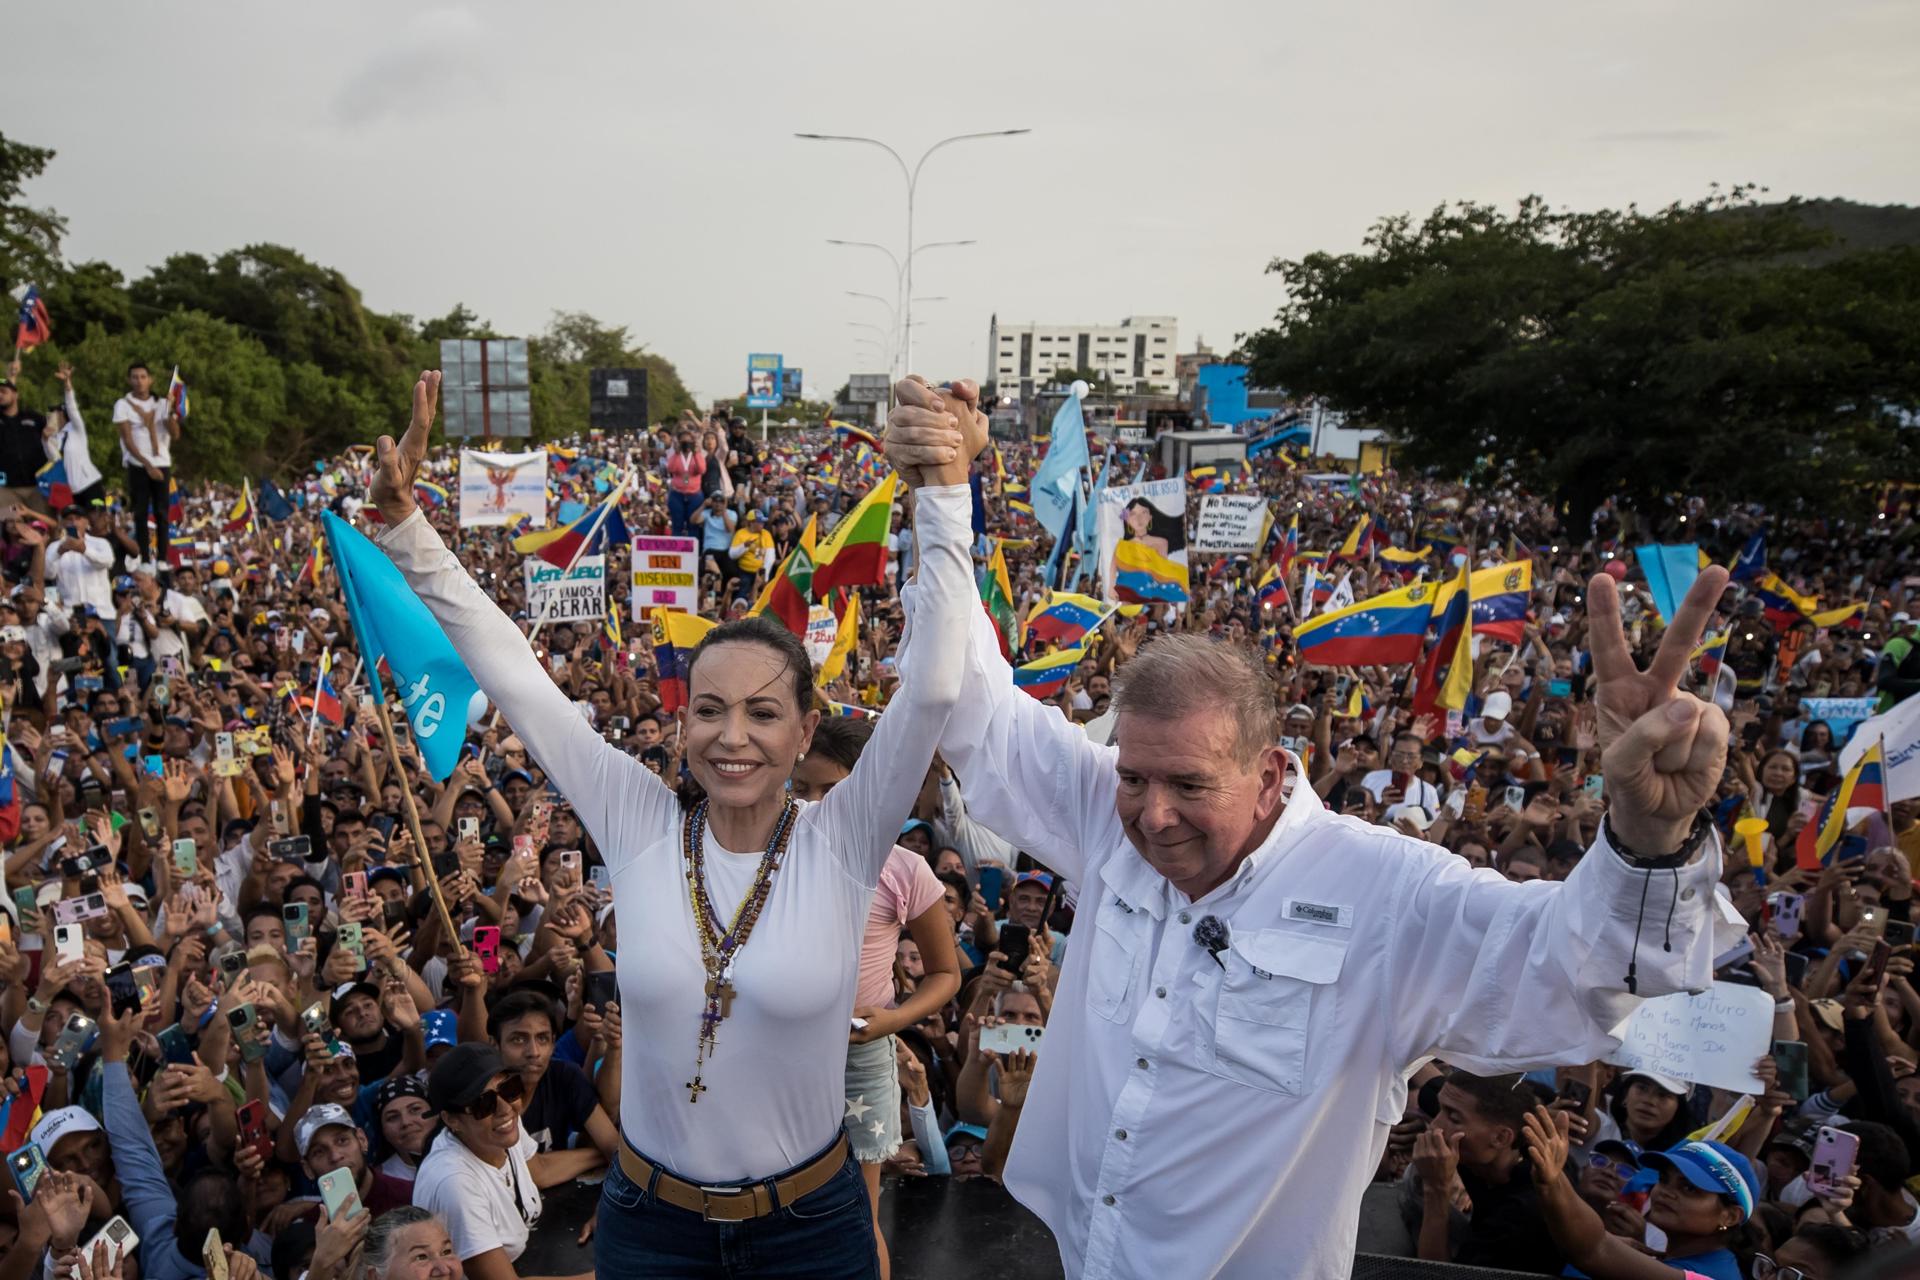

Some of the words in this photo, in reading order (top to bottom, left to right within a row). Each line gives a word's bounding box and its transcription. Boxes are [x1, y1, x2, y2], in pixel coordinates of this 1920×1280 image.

[1206, 498, 1219, 508] NO
[560, 585, 594, 598] VAMOS
[597, 585, 602, 598] A
[528, 598, 602, 619] LIBERAR
[1303, 906, 1333, 918] Columbia
[1664, 1010, 1680, 1026] tus
[1690, 1016, 1726, 1032] Manos
[1656, 1032, 1690, 1051] Mano
